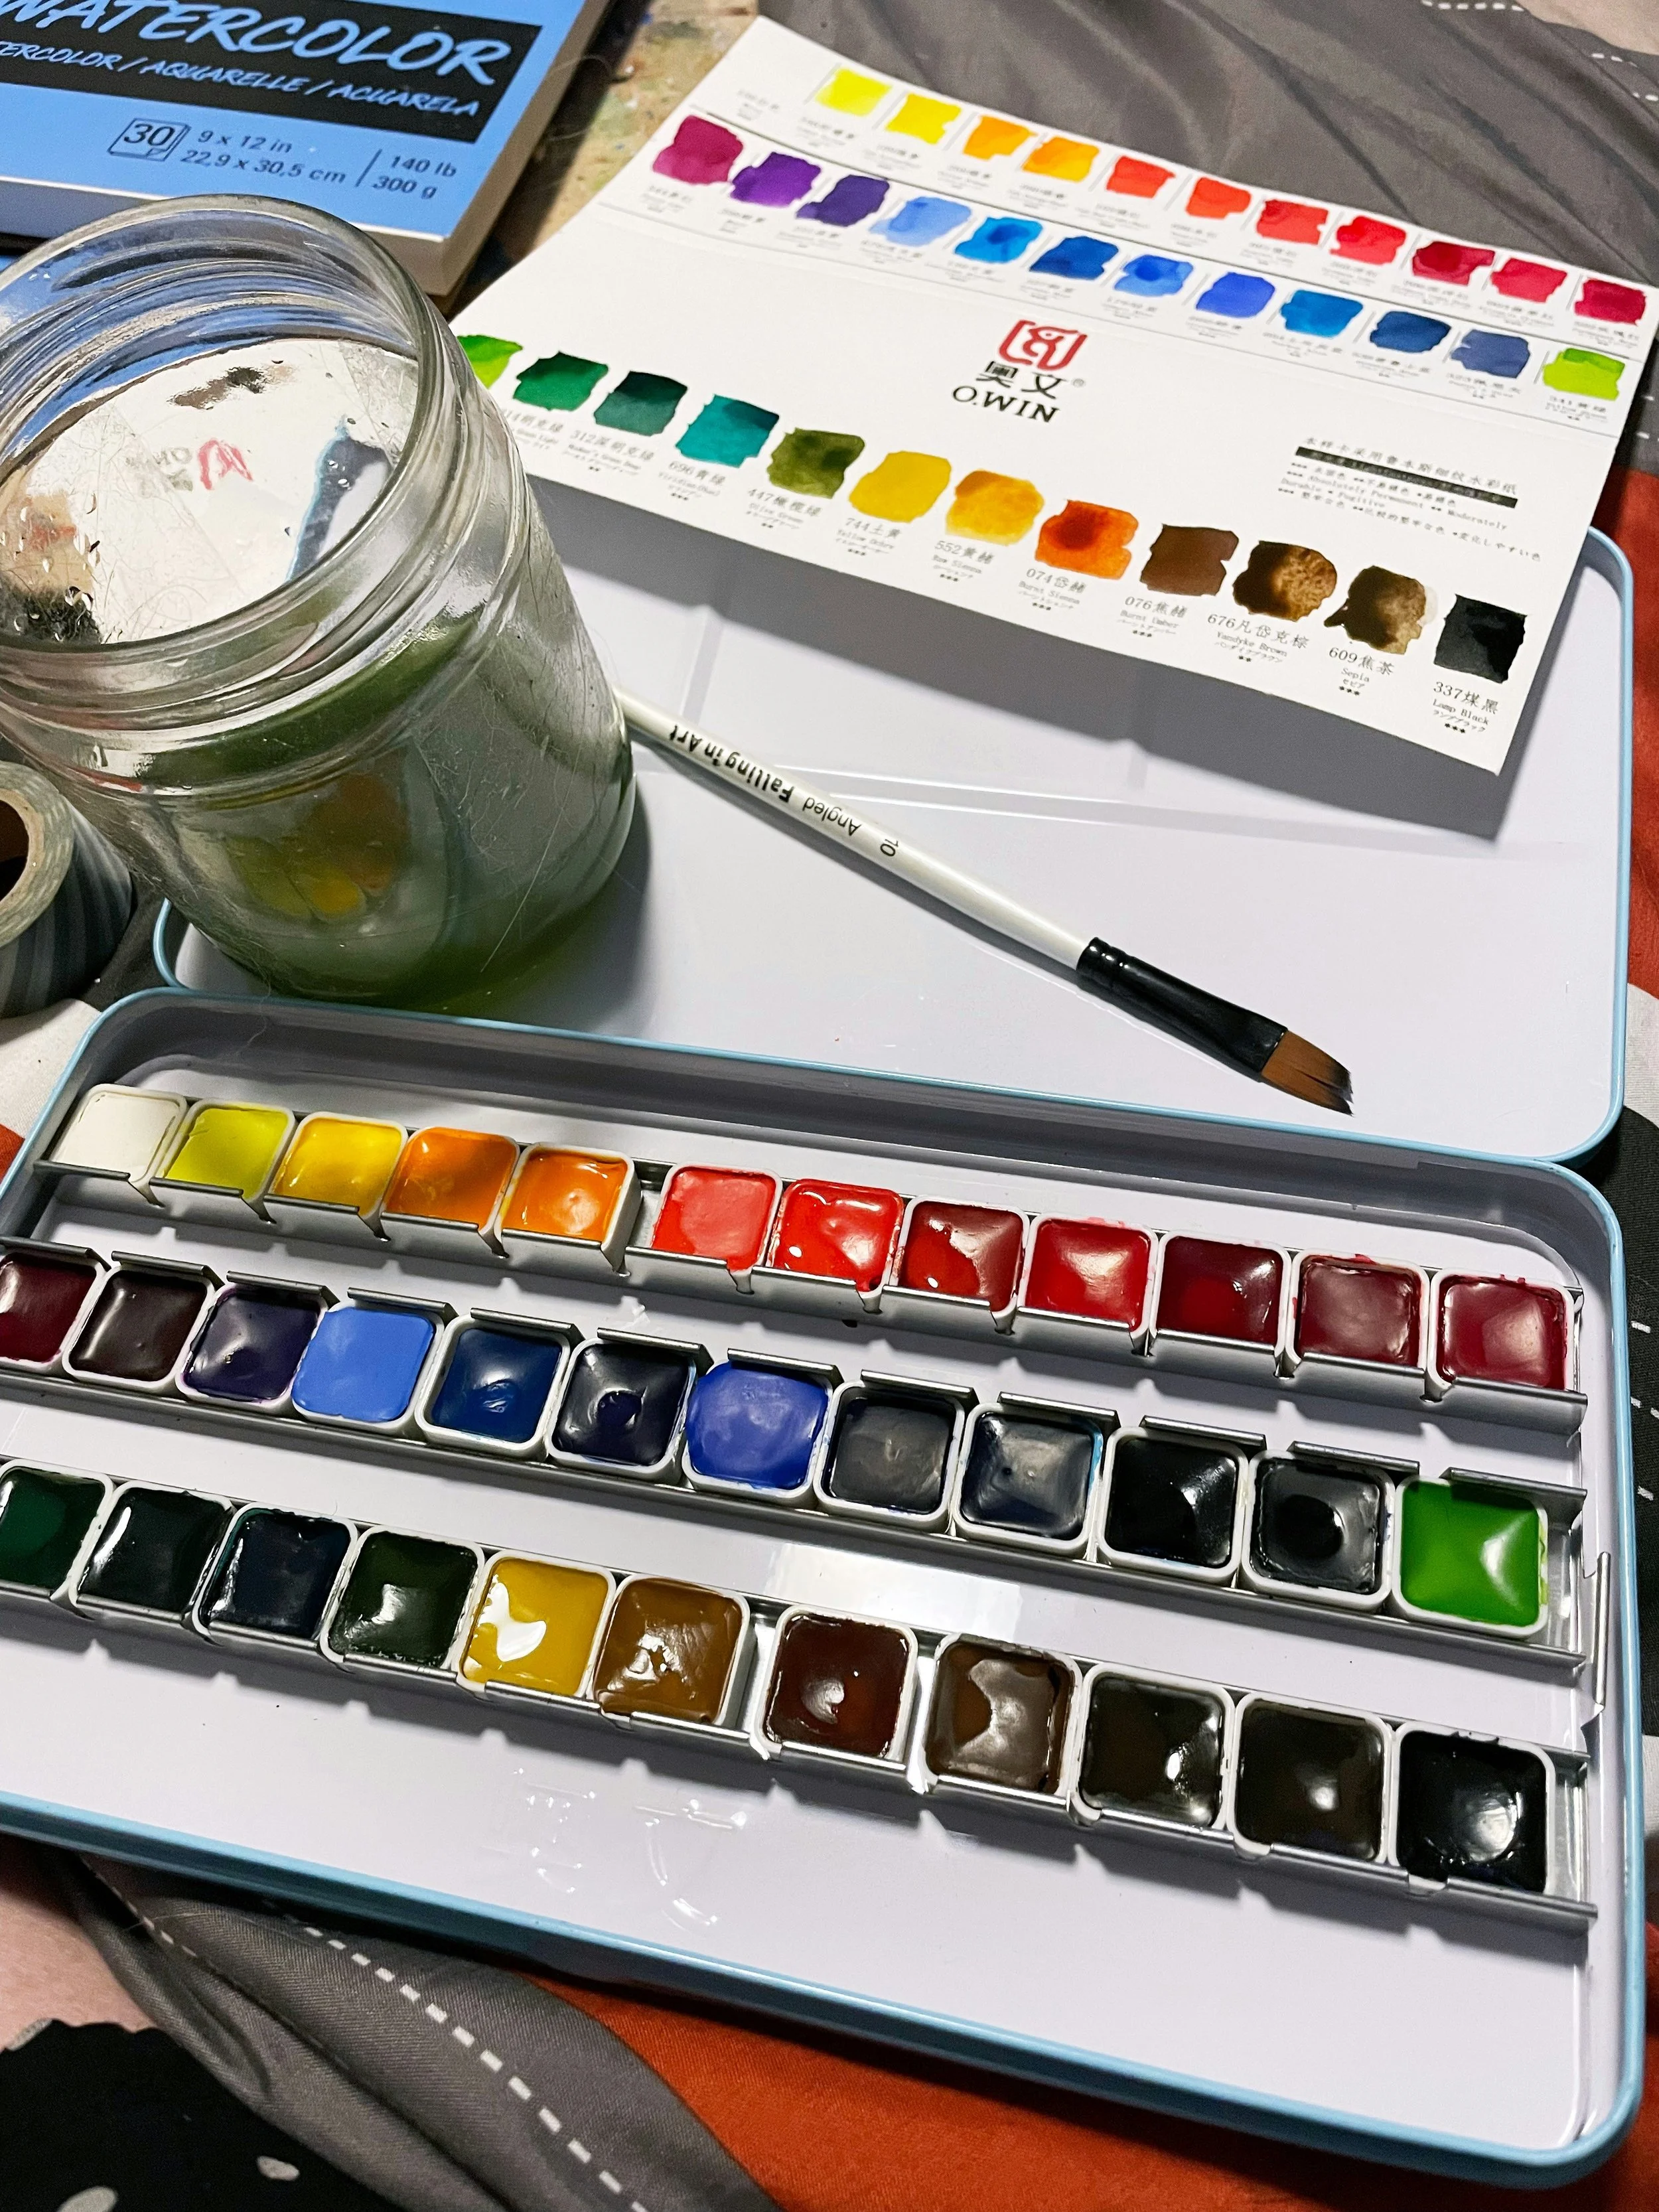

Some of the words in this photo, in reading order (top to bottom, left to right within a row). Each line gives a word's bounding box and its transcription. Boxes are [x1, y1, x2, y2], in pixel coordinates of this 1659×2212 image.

[140, 60, 311, 92] AQUARELLE
[327, 83, 480, 117] ACUARELA
[123, 123, 175, 147] 30
[198, 130, 214, 143] 9
[218, 135, 232, 145] x
[242, 135, 267, 150] 12
[269, 137, 292, 153] in
[236, 159, 248, 170] x
[309, 169, 348, 183] cm
[391, 155, 431, 175] 140
[435, 161, 457, 177] lb
[372, 175, 417, 194] 300
[421, 186, 438, 200] g
[1447, 508, 1508, 532] Moderately
[1019, 581, 1044, 594] Burnt
[1048, 589, 1080, 605] Sienna
[1120, 609, 1146, 622] Burnt
[1152, 617, 1179, 628] Umber
[1217, 631, 1254, 647] Vandyke
[1260, 642, 1288, 657] Brown
[1329, 646, 1395, 676] 609焦茶
[1341, 667, 1370, 683] Sepia
[1433, 698, 1456, 714] Lamp
[1461, 709, 1489, 725] Black
[668, 724, 703, 753] Art
[703, 742, 725, 767] in
[726, 751, 795, 804] Falling
[802, 796, 863, 837] Angled
[880, 838, 899, 857] 10
